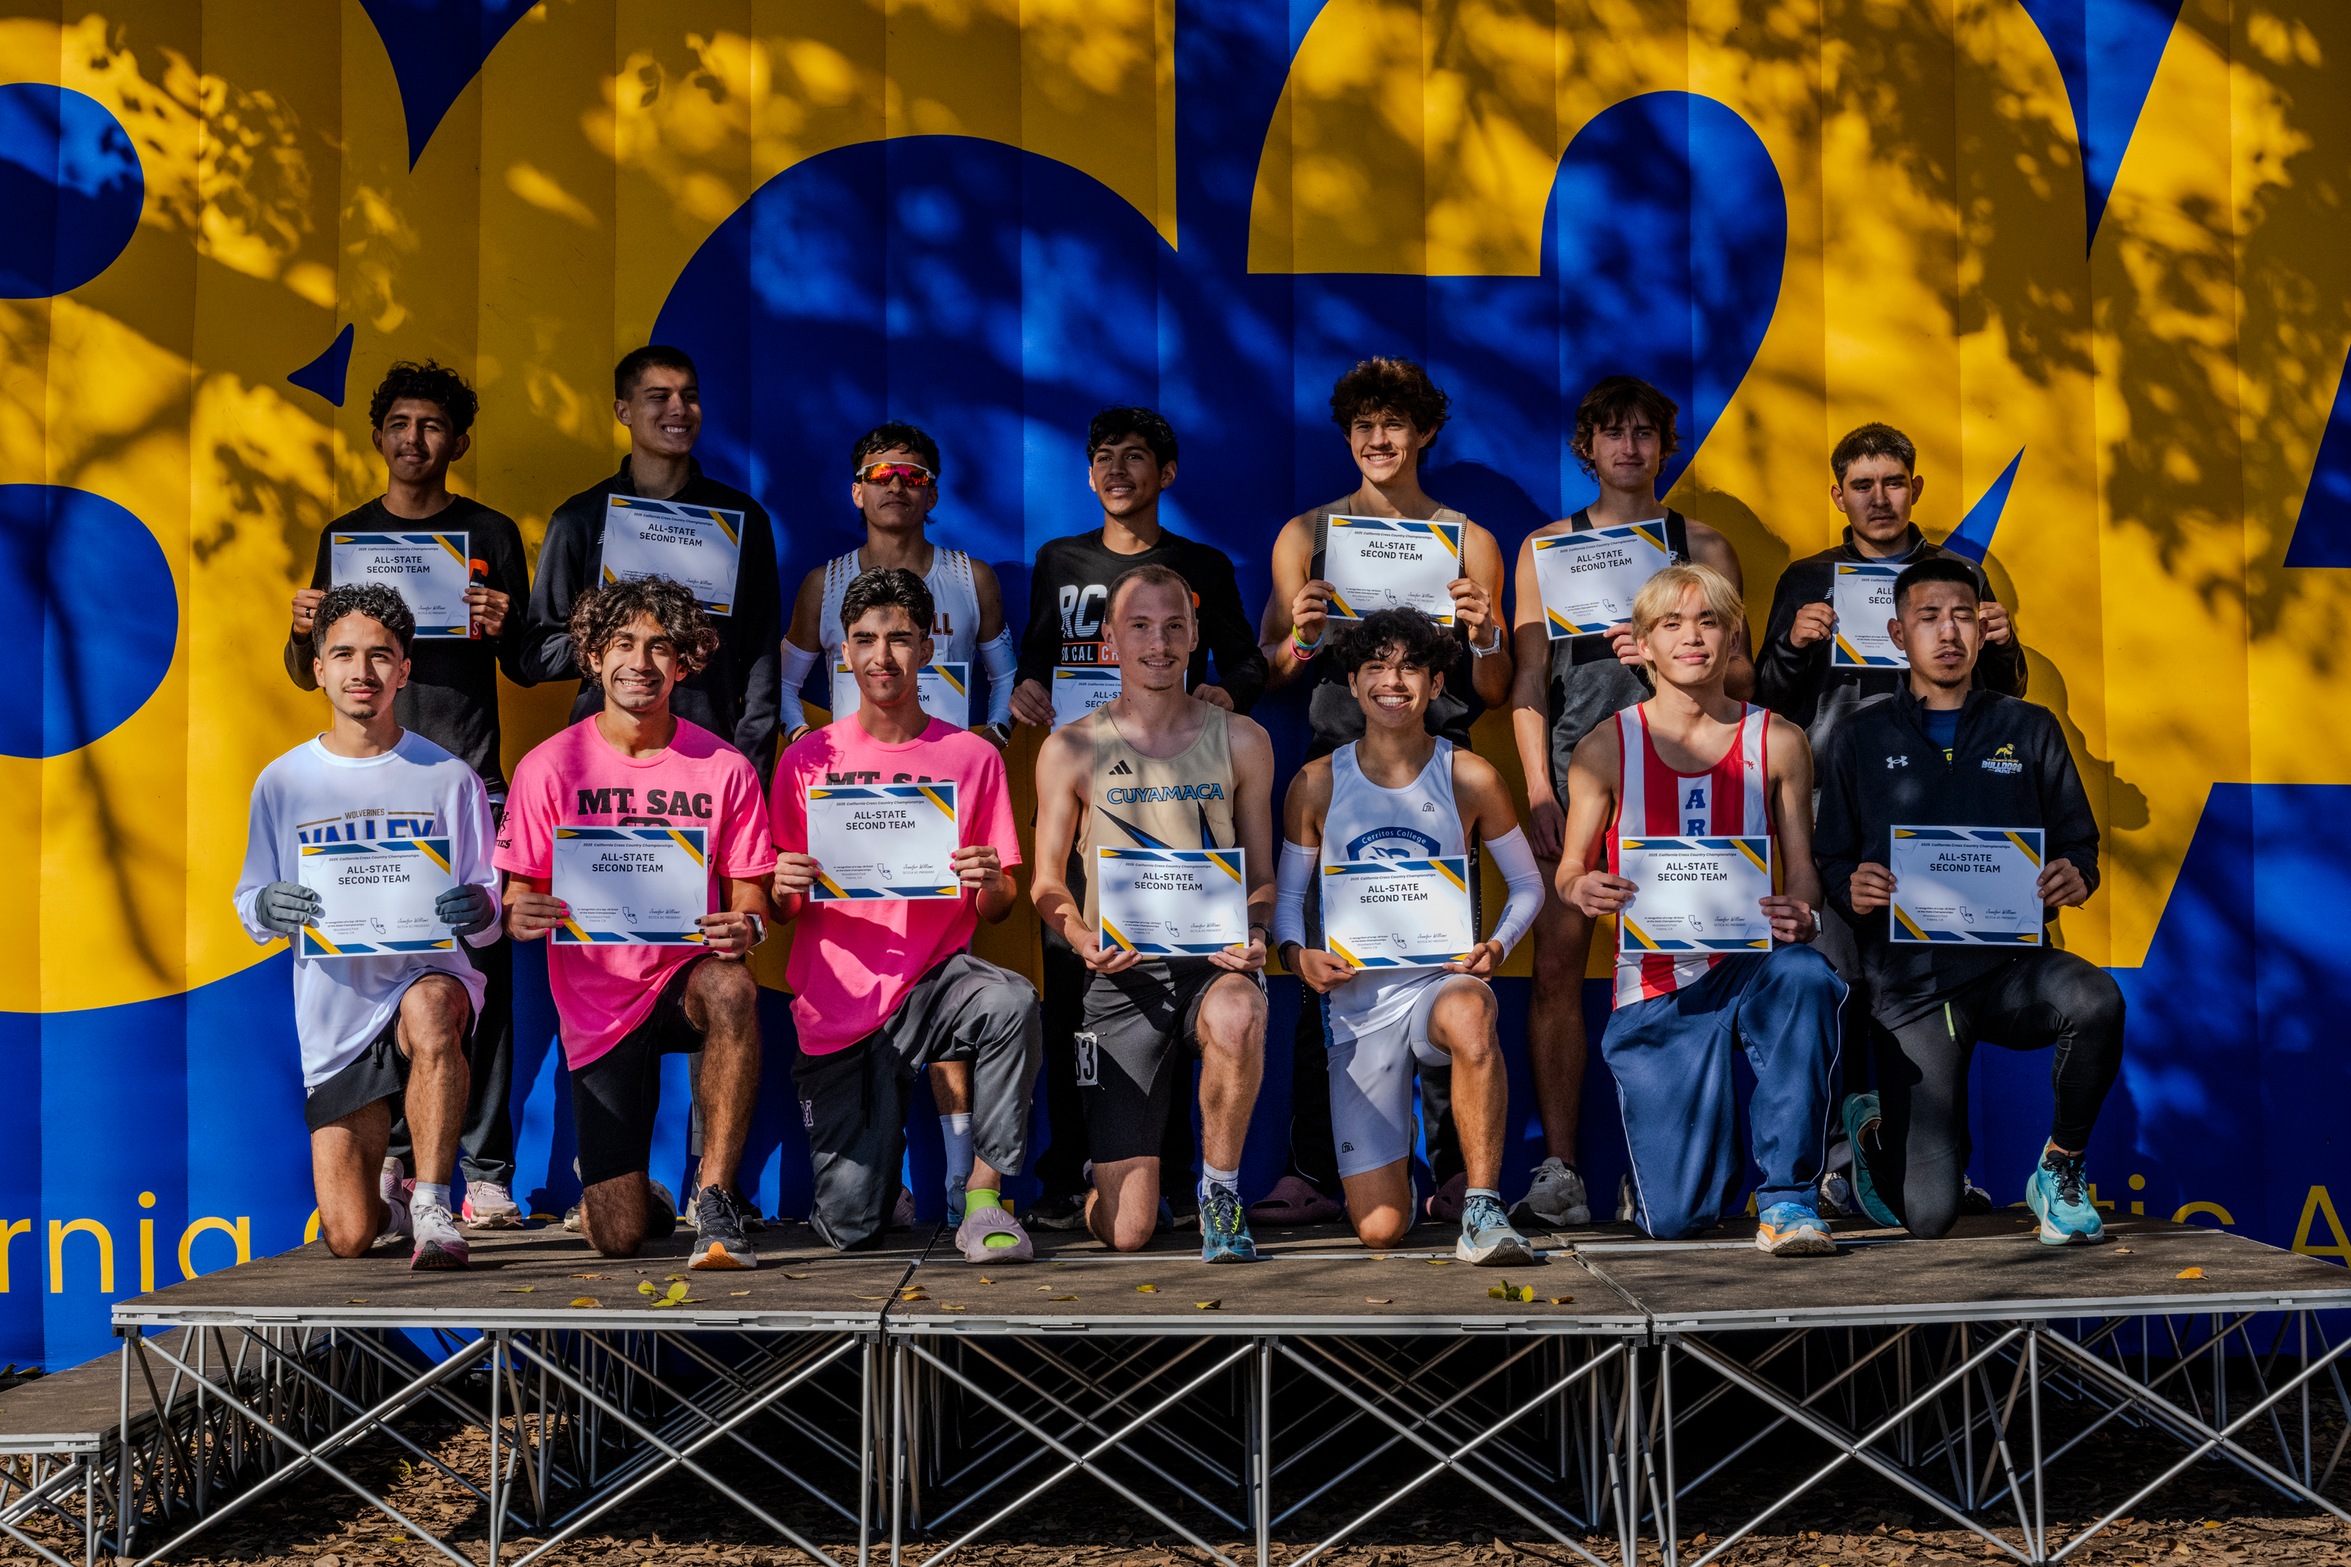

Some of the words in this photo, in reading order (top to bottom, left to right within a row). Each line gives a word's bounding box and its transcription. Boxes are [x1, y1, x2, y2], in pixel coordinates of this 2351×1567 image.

[647, 523, 695, 536] ALL-STATE
[639, 531, 676, 543] SECOND
[677, 536, 702, 546] TEAM
[1368, 540, 1415, 550] ALL-STATE
[374, 555, 422, 563] ALL-STATE
[1360, 549, 1396, 558] SECOND
[1398, 552, 1422, 560] TEAM
[1575, 548, 1623, 563] ALL-STATE
[366, 565, 403, 573] SECOND
[405, 565, 430, 573] TEAM
[1569, 560, 1606, 573] SECOND
[1607, 557, 1632, 568] TEAM
[1868, 596, 1895, 604] SECO
[1071, 645, 1094, 662] CAL
[1107, 783, 1224, 805] CUYAMACA
[577, 788, 637, 815] MT.
[646, 789, 713, 818] SAC
[345, 808, 385, 820] WOLVERINES
[853, 809, 906, 819] ALL-STATE
[845, 820, 886, 830] SECOND
[888, 820, 915, 829] TEAM
[1361, 830, 1394, 844] Cerritos
[1396, 830, 1427, 845] College
[600, 852, 654, 861] ALL-STATE
[1938, 852, 1991, 861] ALL-STATE
[346, 863, 400, 874] ALL-STATE
[591, 863, 633, 871] SECOND
[635, 864, 663, 872] TEAM
[1665, 861, 1718, 870] ALL-STATE
[1929, 863, 1970, 871] SECOND
[1972, 864, 2000, 872] TEAM
[338, 874, 379, 885] SECOND
[382, 873, 410, 883] TEAM
[1142, 872, 1193, 880] ALL-STATE
[1657, 872, 1697, 881] SECOND
[1700, 872, 1727, 880] TEAM
[1134, 881, 1173, 889] SECOND
[1367, 882, 1418, 893] ALL-STATE
[1359, 893, 1399, 903] SECOND
[1401, 892, 1428, 901] TEAM
